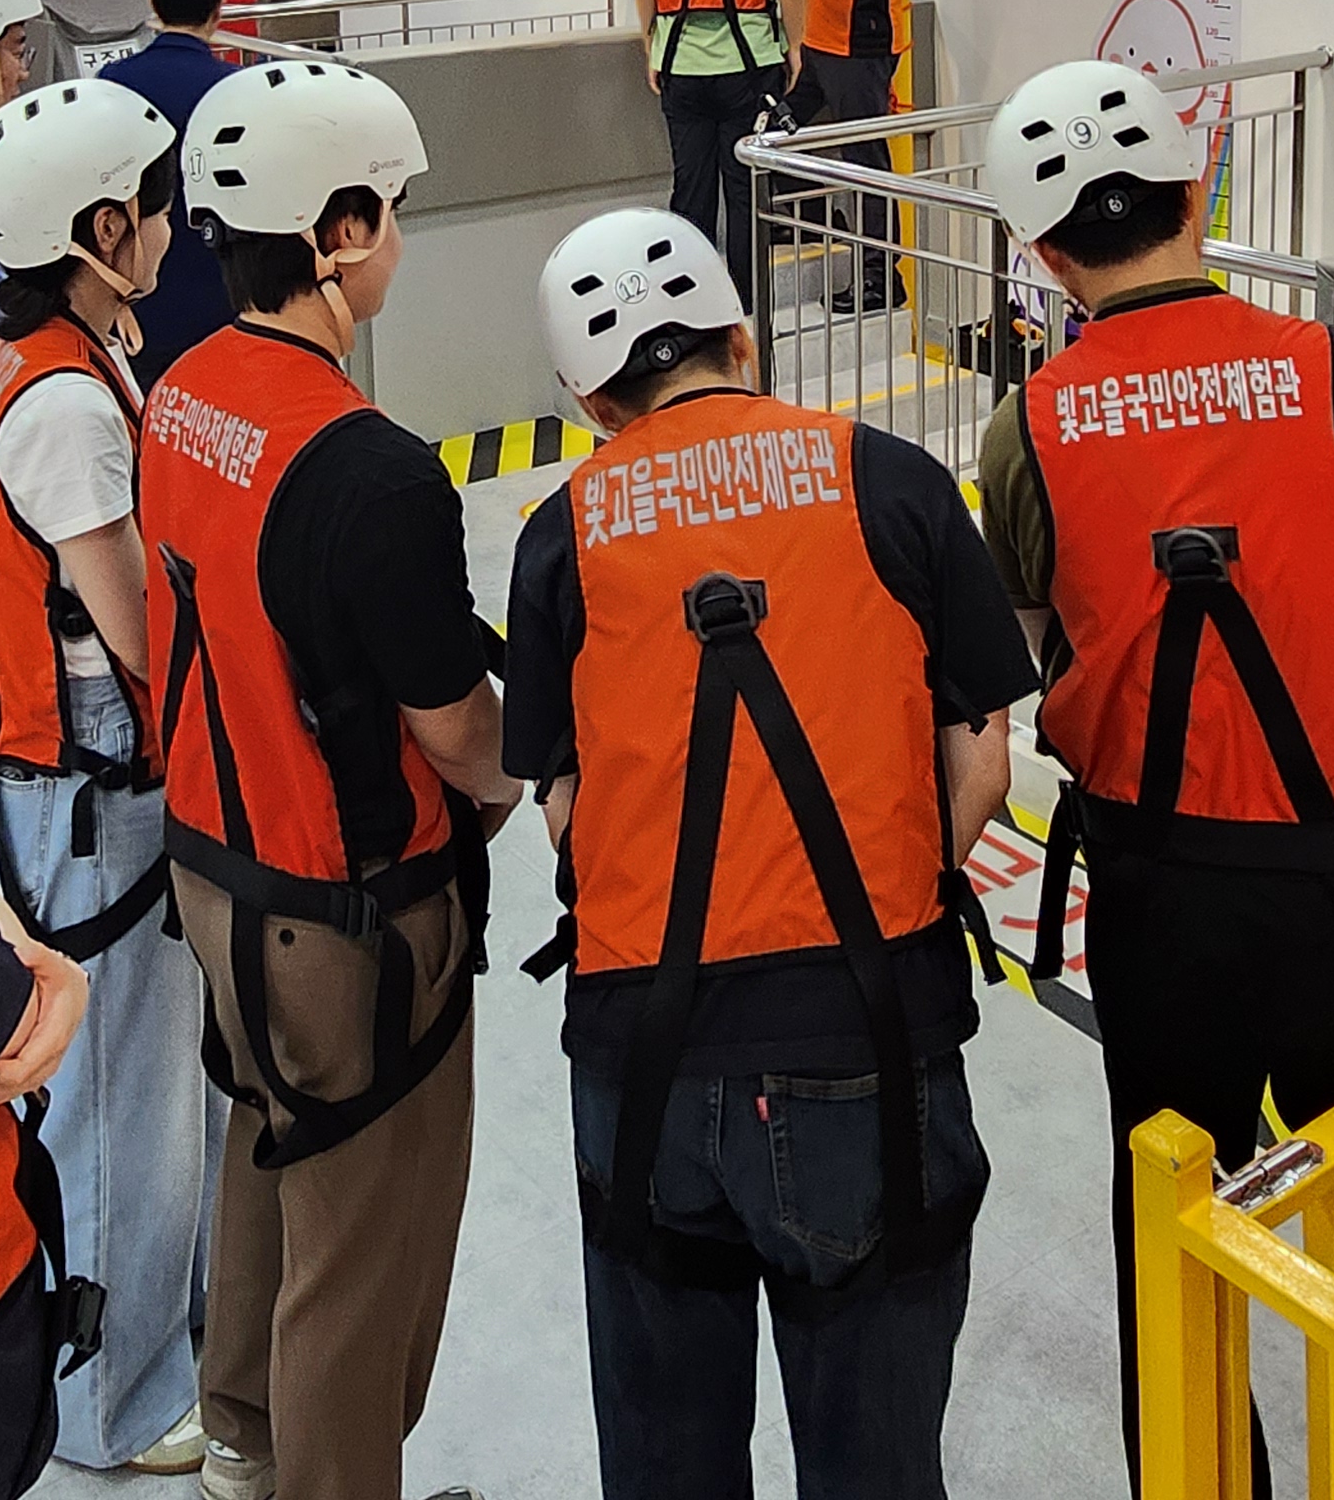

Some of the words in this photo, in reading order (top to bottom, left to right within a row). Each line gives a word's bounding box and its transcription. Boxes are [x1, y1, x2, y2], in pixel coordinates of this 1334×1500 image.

[1073, 121, 1092, 144] 9
[189, 152, 202, 176] 17
[618, 273, 647, 301] 12
[1055, 356, 1304, 445] 빛고을국민안전체험관
[584, 428, 842, 550] 빛고을국민안전체험관
